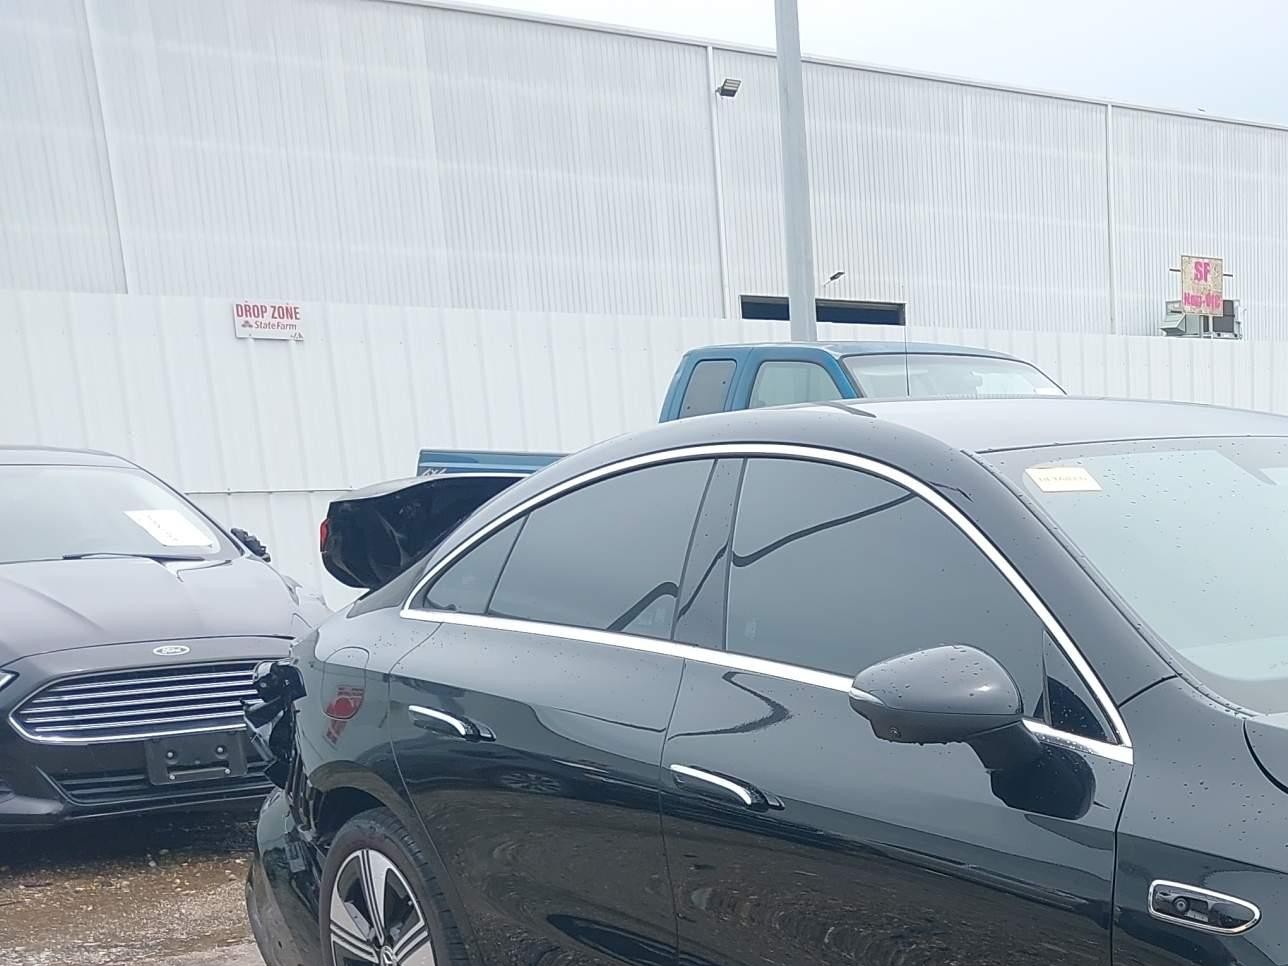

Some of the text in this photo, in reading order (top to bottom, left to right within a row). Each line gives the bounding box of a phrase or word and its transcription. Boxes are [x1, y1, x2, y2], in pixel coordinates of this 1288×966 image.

[1194, 261, 1210, 282] SF
[236, 303, 301, 321] DROP ZONE
